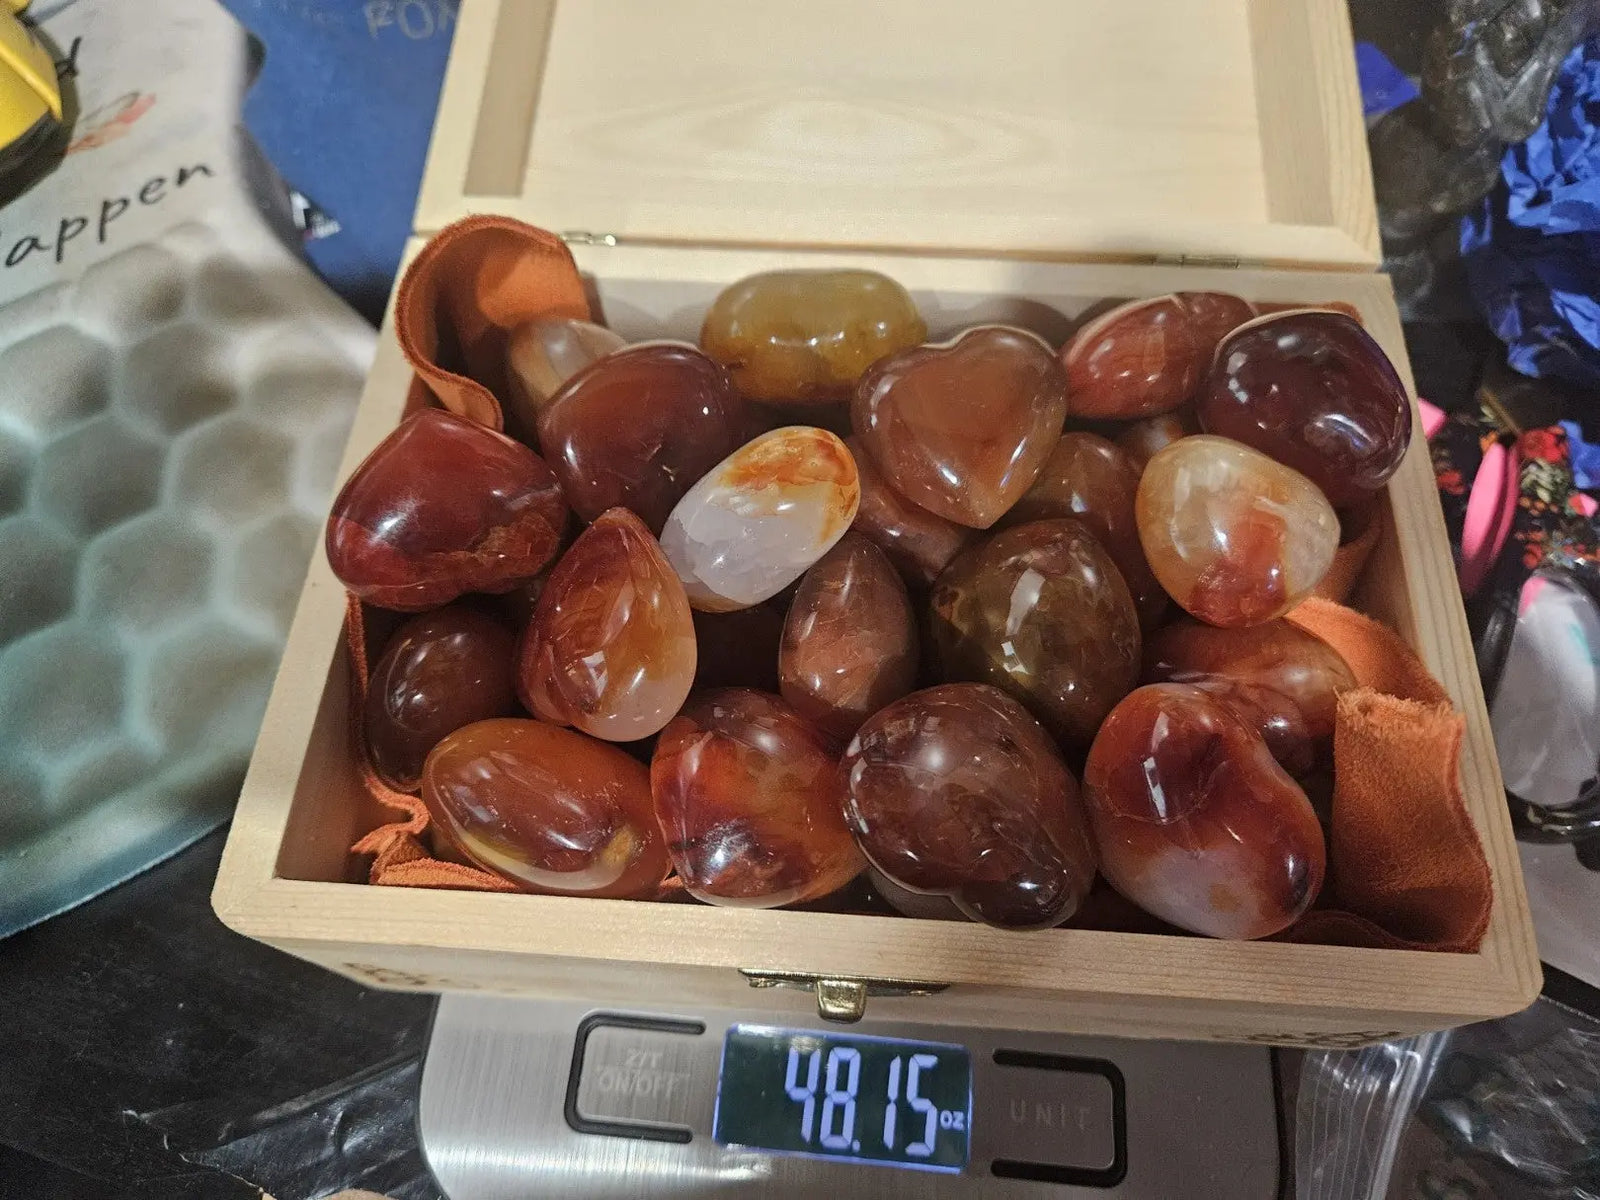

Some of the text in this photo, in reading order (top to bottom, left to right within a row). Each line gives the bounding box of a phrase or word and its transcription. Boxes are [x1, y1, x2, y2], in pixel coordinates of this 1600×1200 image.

[1, 162, 214, 268] appen
[785, 1045, 938, 1157] 48.15
[1010, 1099, 1091, 1131] UNIT
